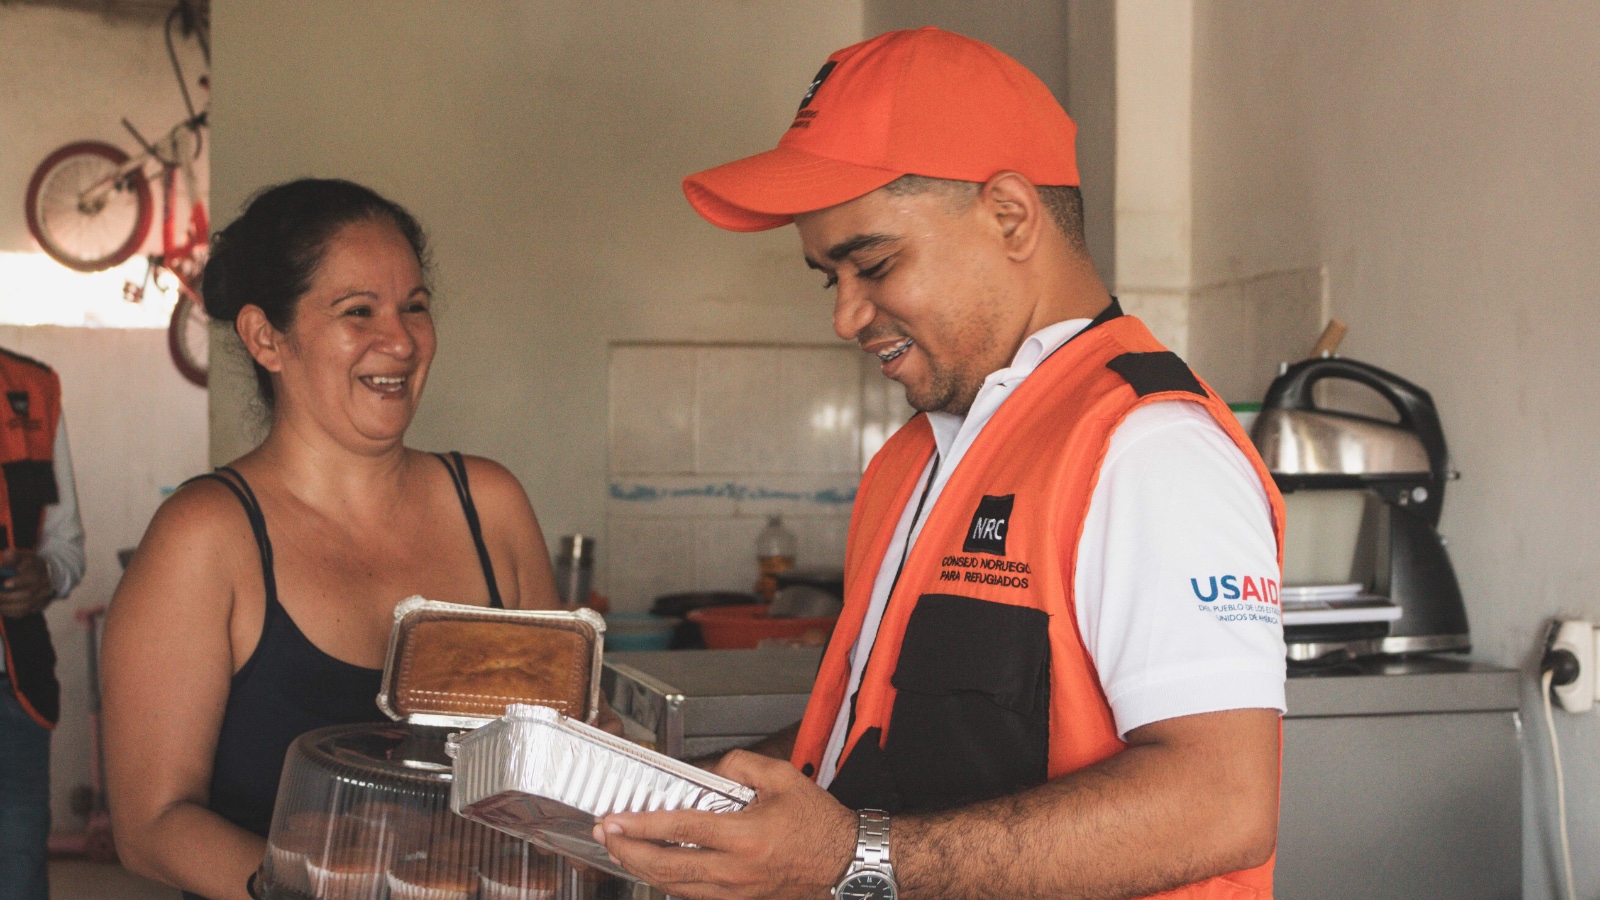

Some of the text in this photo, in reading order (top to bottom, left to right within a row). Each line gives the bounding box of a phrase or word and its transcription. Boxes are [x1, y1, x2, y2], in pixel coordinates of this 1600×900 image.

[973, 517, 1005, 540] NRC
[942, 556, 978, 568] CONSEJO
[940, 570, 1028, 588] PARA REFUGIADOS
[1191, 575, 1278, 605] USAID
[1198, 604, 1212, 612] DEL
[1213, 604, 1244, 612] PUEBLO
[1255, 605, 1266, 613] LOS
[1216, 613, 1247, 621] UNIDOS
[1249, 613, 1258, 621] DE
